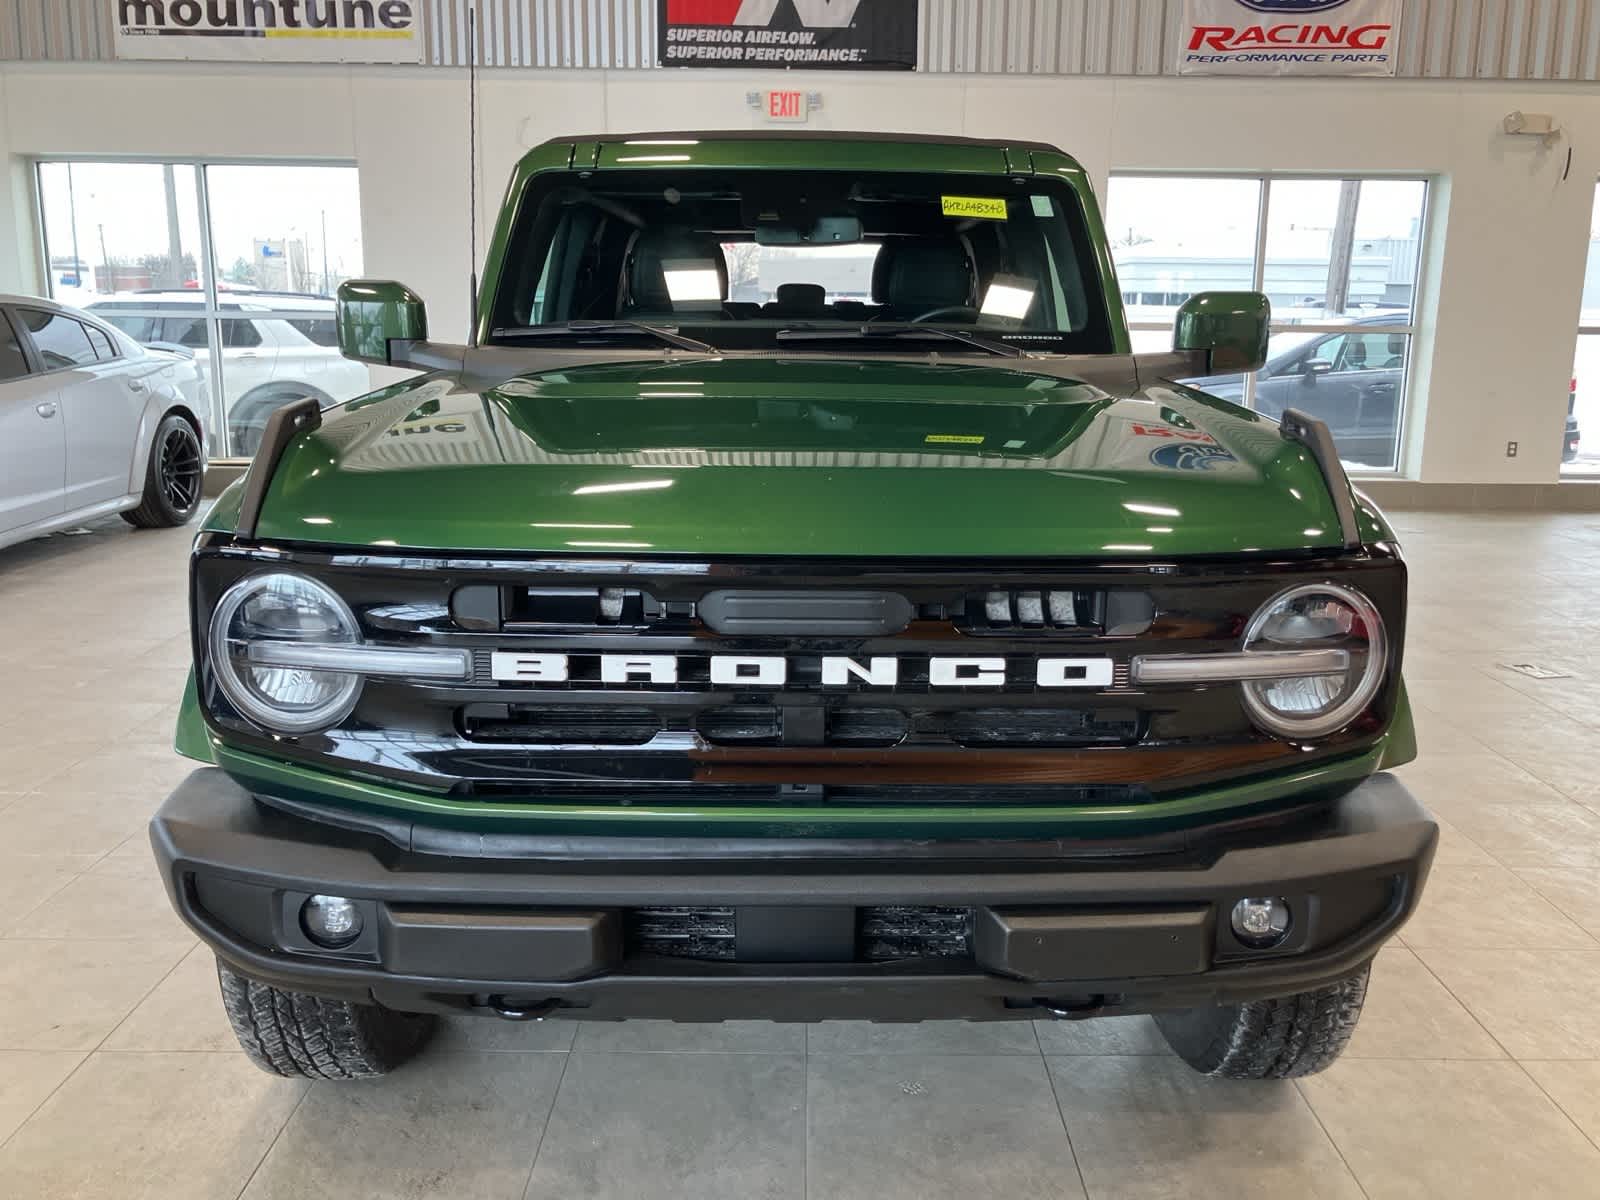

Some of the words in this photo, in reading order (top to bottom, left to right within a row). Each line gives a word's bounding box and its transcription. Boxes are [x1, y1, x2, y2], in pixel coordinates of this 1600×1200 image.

[119, 0, 413, 28] mountune
[666, 28, 743, 42] SUPERIOR
[744, 30, 816, 45] AIRFLOW.
[1188, 25, 1391, 51] RACING
[666, 45, 743, 59] SUPERIOR
[1186, 54, 1327, 62] PERFORMANCE
[1331, 54, 1388, 62] PARTS
[770, 91, 802, 117] EXIT
[491, 651, 1113, 687] BRONCO
